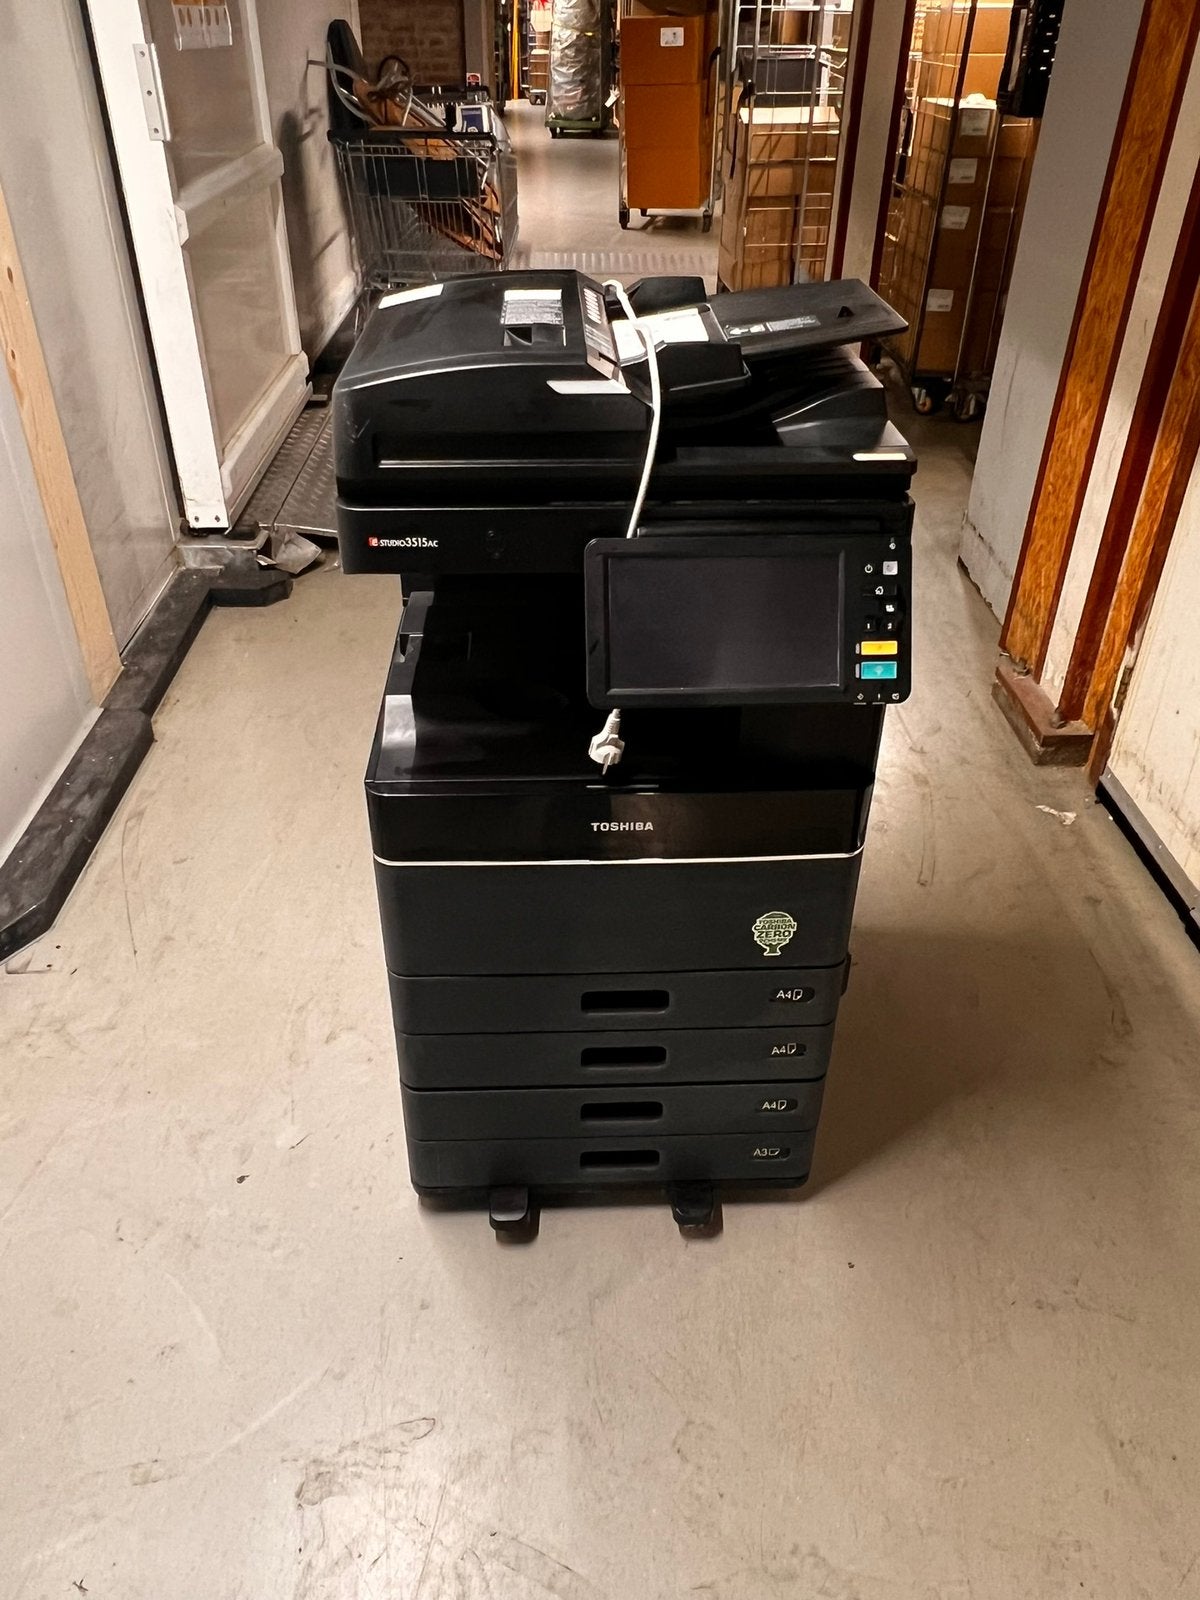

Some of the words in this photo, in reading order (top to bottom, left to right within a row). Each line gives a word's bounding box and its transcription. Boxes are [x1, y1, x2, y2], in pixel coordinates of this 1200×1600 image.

[590, 822, 654, 831] TOSHIBA
[757, 930, 791, 938] ZERO
[776, 989, 791, 999] A4
[771, 1046, 786, 1055] A4
[762, 1101, 776, 1109] A4
[753, 1148, 768, 1156] A3
